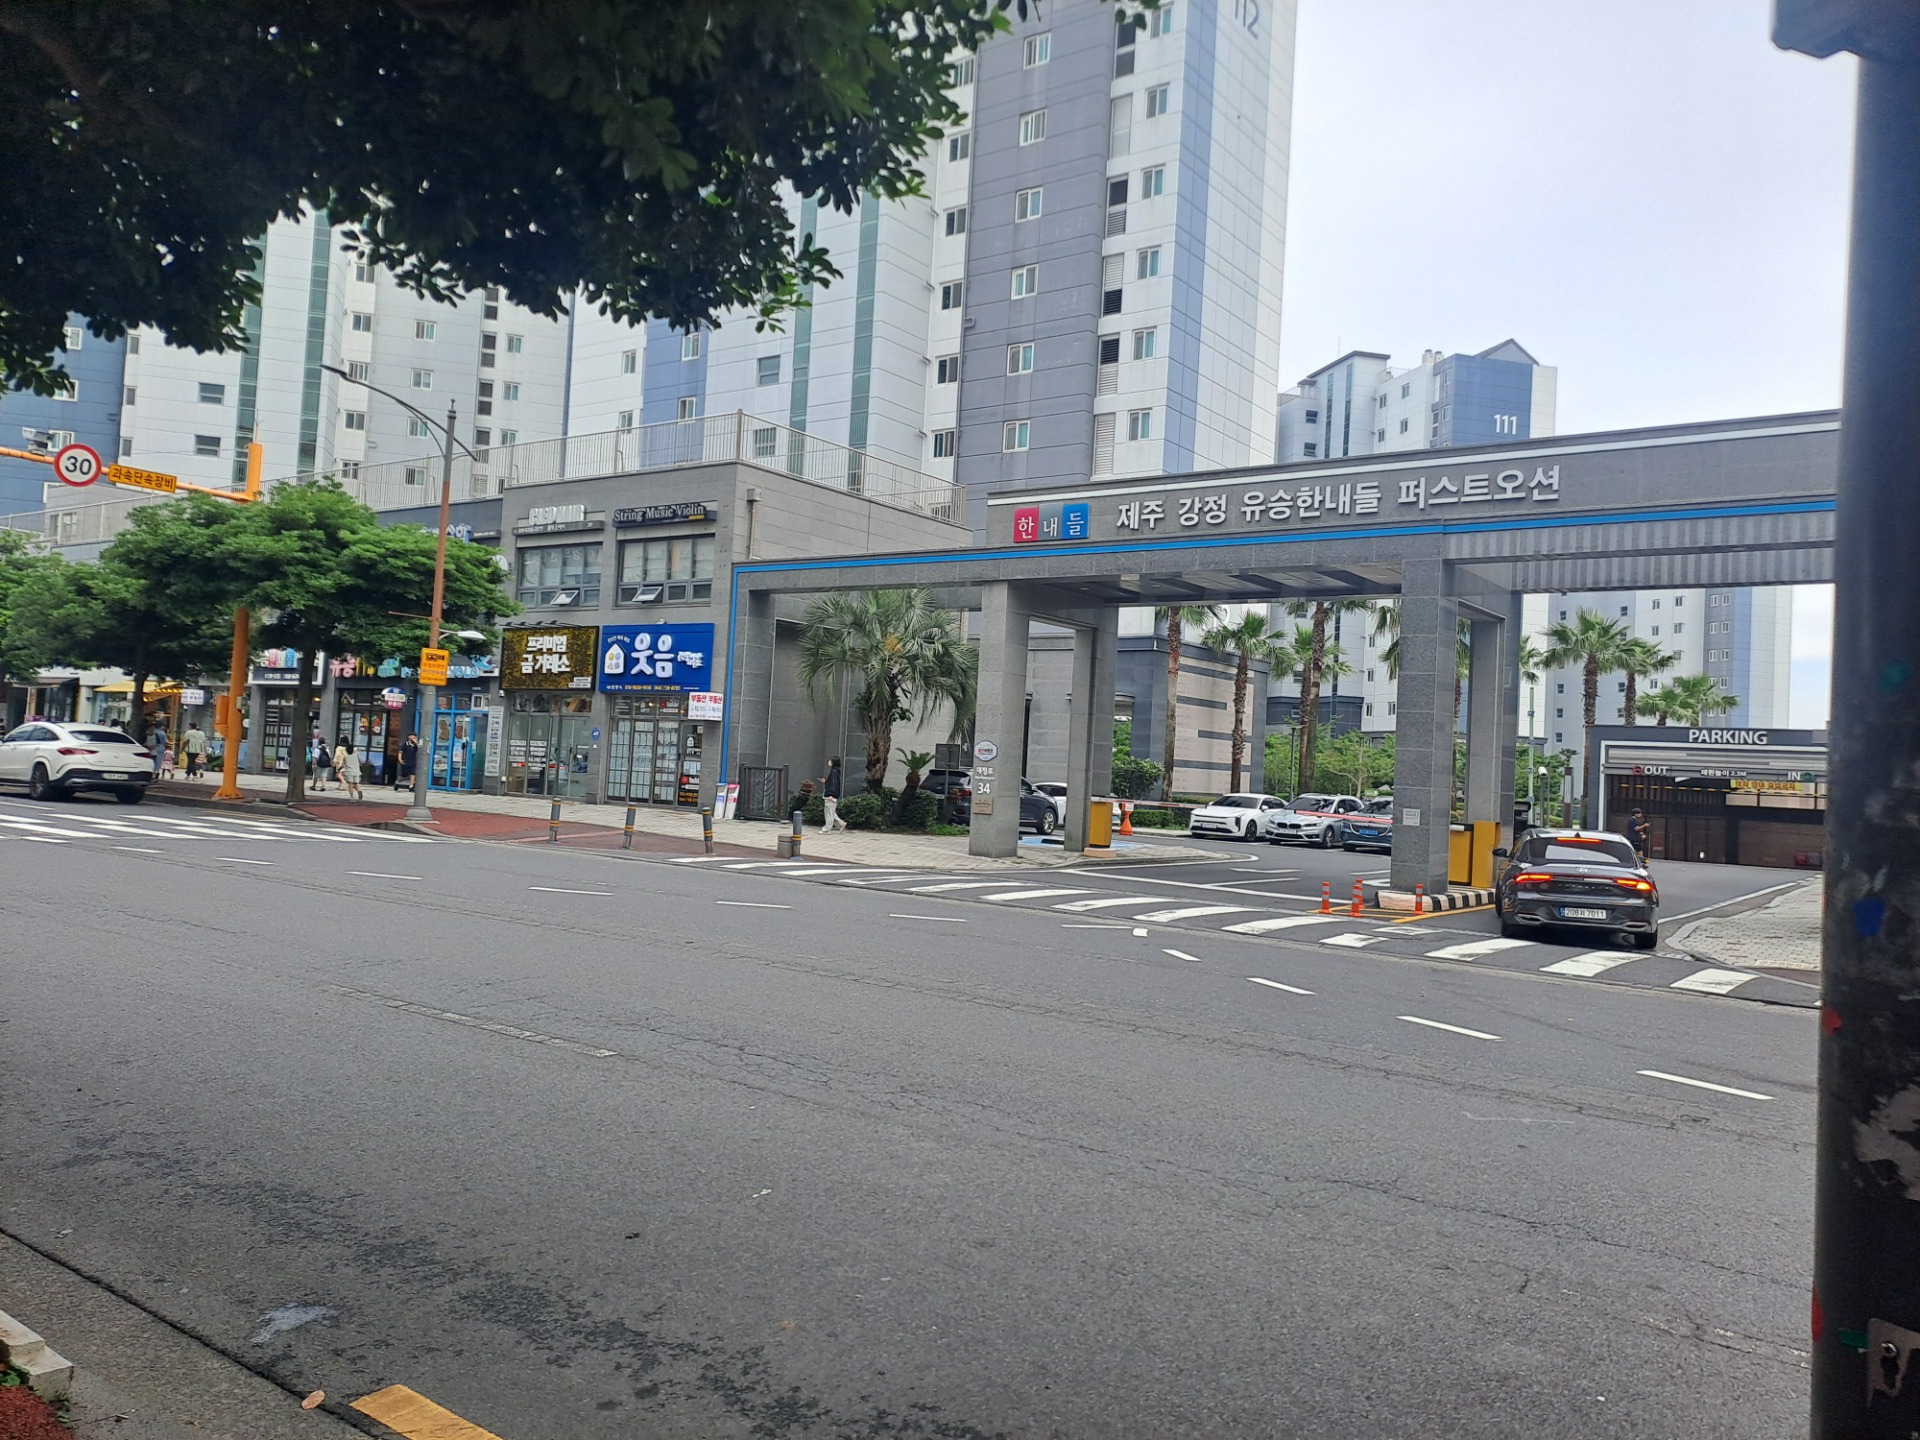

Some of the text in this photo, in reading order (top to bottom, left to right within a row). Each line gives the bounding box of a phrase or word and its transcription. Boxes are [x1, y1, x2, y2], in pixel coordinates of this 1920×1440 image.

[1494, 414, 1517, 435] 111
[65, 456, 92, 475] 30
[112, 467, 174, 490] 과속단속장비
[1116, 465, 1560, 530] 제주 강정 유승한내들 퍼스트오션
[614, 509, 643, 522] String
[645, 506, 673, 519] Music
[675, 503, 704, 516] Violin
[1017, 511, 1084, 539] 한내들
[526, 635, 568, 653] 프리미엄
[630, 632, 675, 678] 웃음
[691, 695, 723, 705] 부동산 부동산
[1688, 730, 1768, 744] PARKING
[1644, 766, 1669, 775] OUT
[1700, 768, 1729, 777] 제한높이
[1787, 771, 1801, 780] IN
[977, 782, 991, 794] 34
